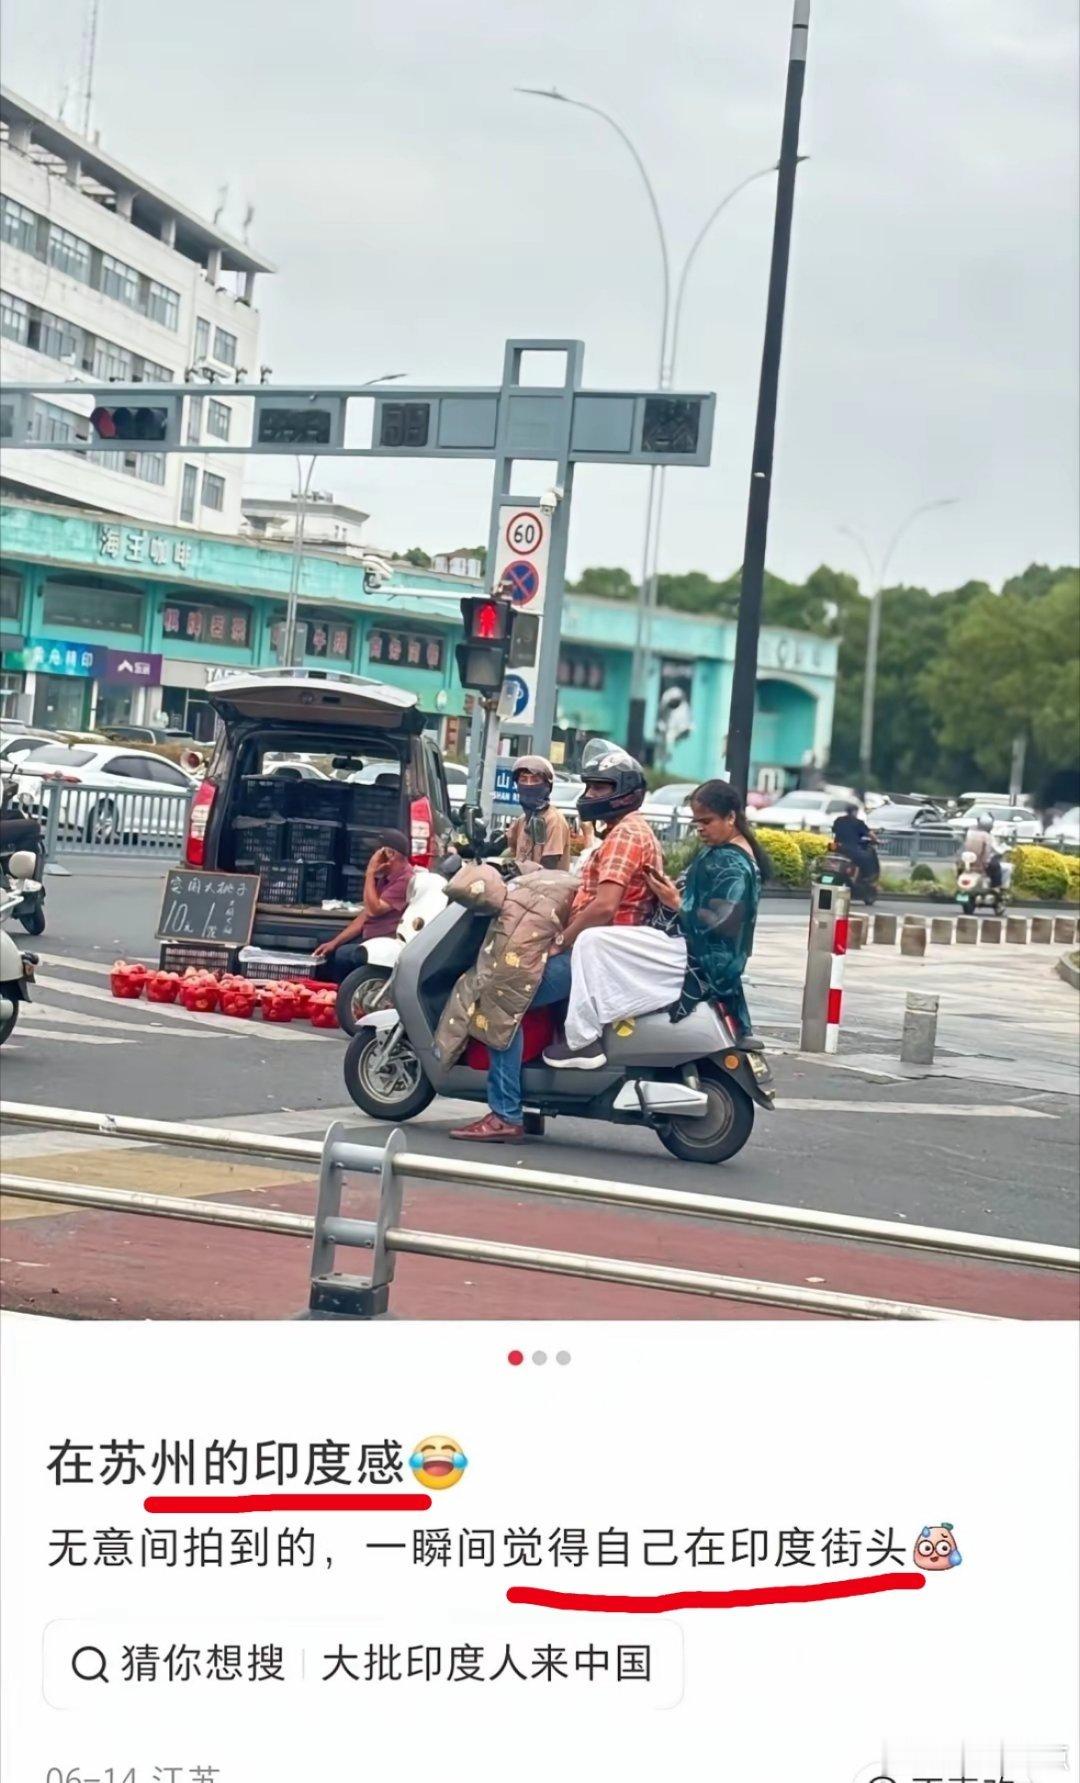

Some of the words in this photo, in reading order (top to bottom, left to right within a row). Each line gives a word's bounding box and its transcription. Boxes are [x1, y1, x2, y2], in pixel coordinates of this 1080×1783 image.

[101, 525, 192, 571] 海王咖啡
[513, 524, 535, 544] 60
